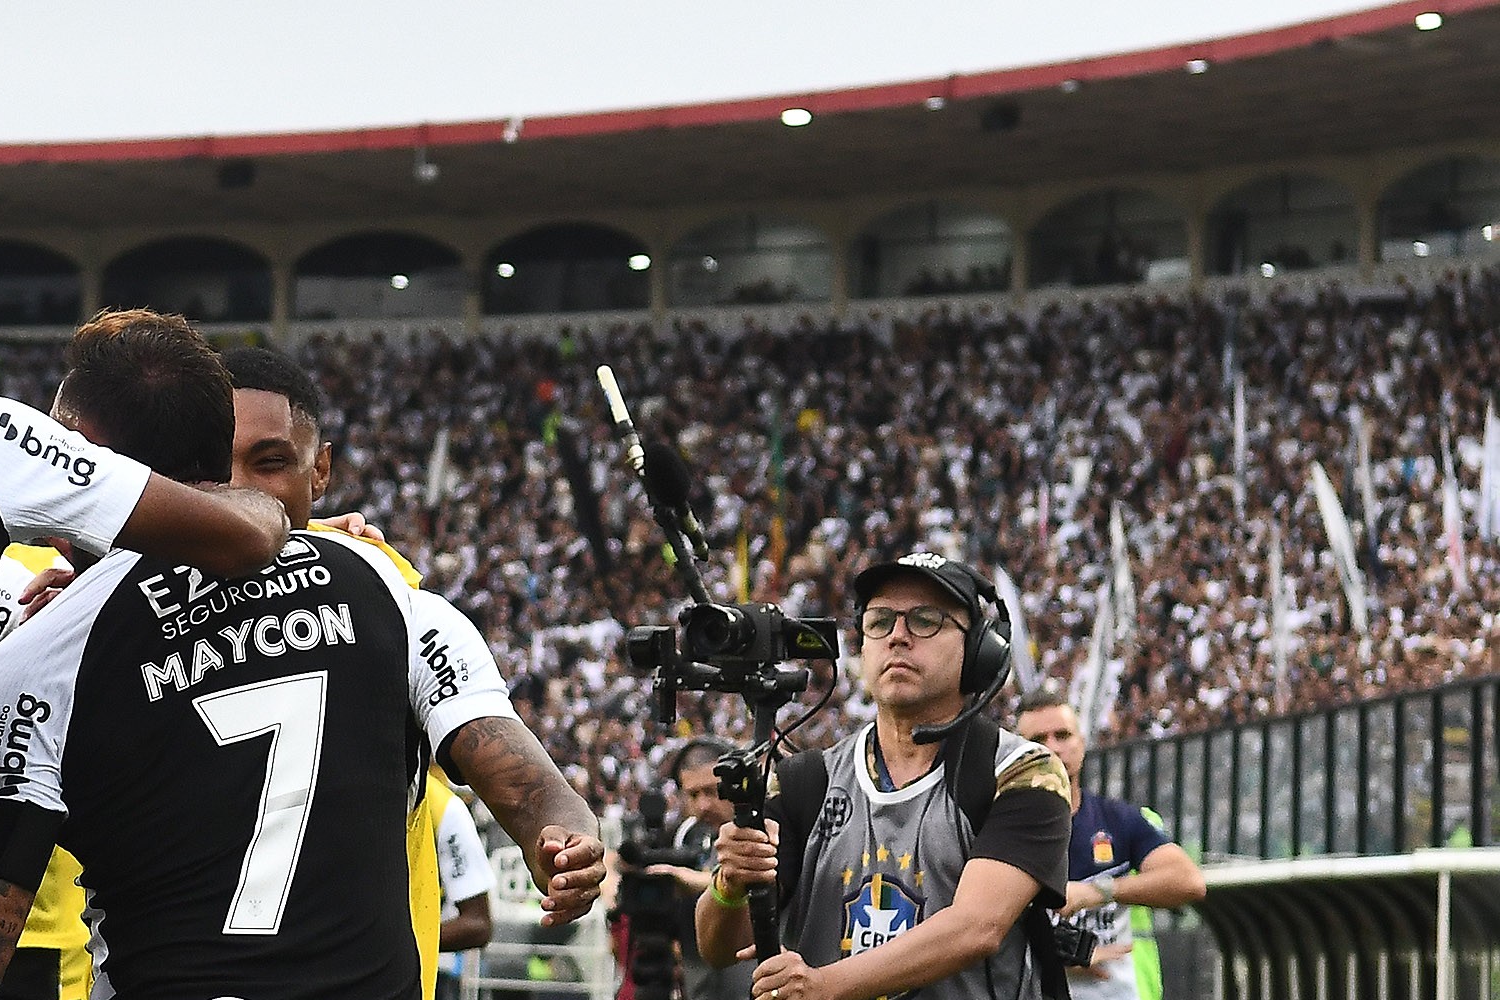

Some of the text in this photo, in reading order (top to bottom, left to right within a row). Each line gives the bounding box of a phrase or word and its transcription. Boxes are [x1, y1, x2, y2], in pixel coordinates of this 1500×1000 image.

[19, 425, 97, 487] bmg
[265, 565, 331, 599] AUTO
[140, 603, 356, 702] MAYCON
[191, 670, 329, 936] 7
[860, 930, 897, 948] CB
